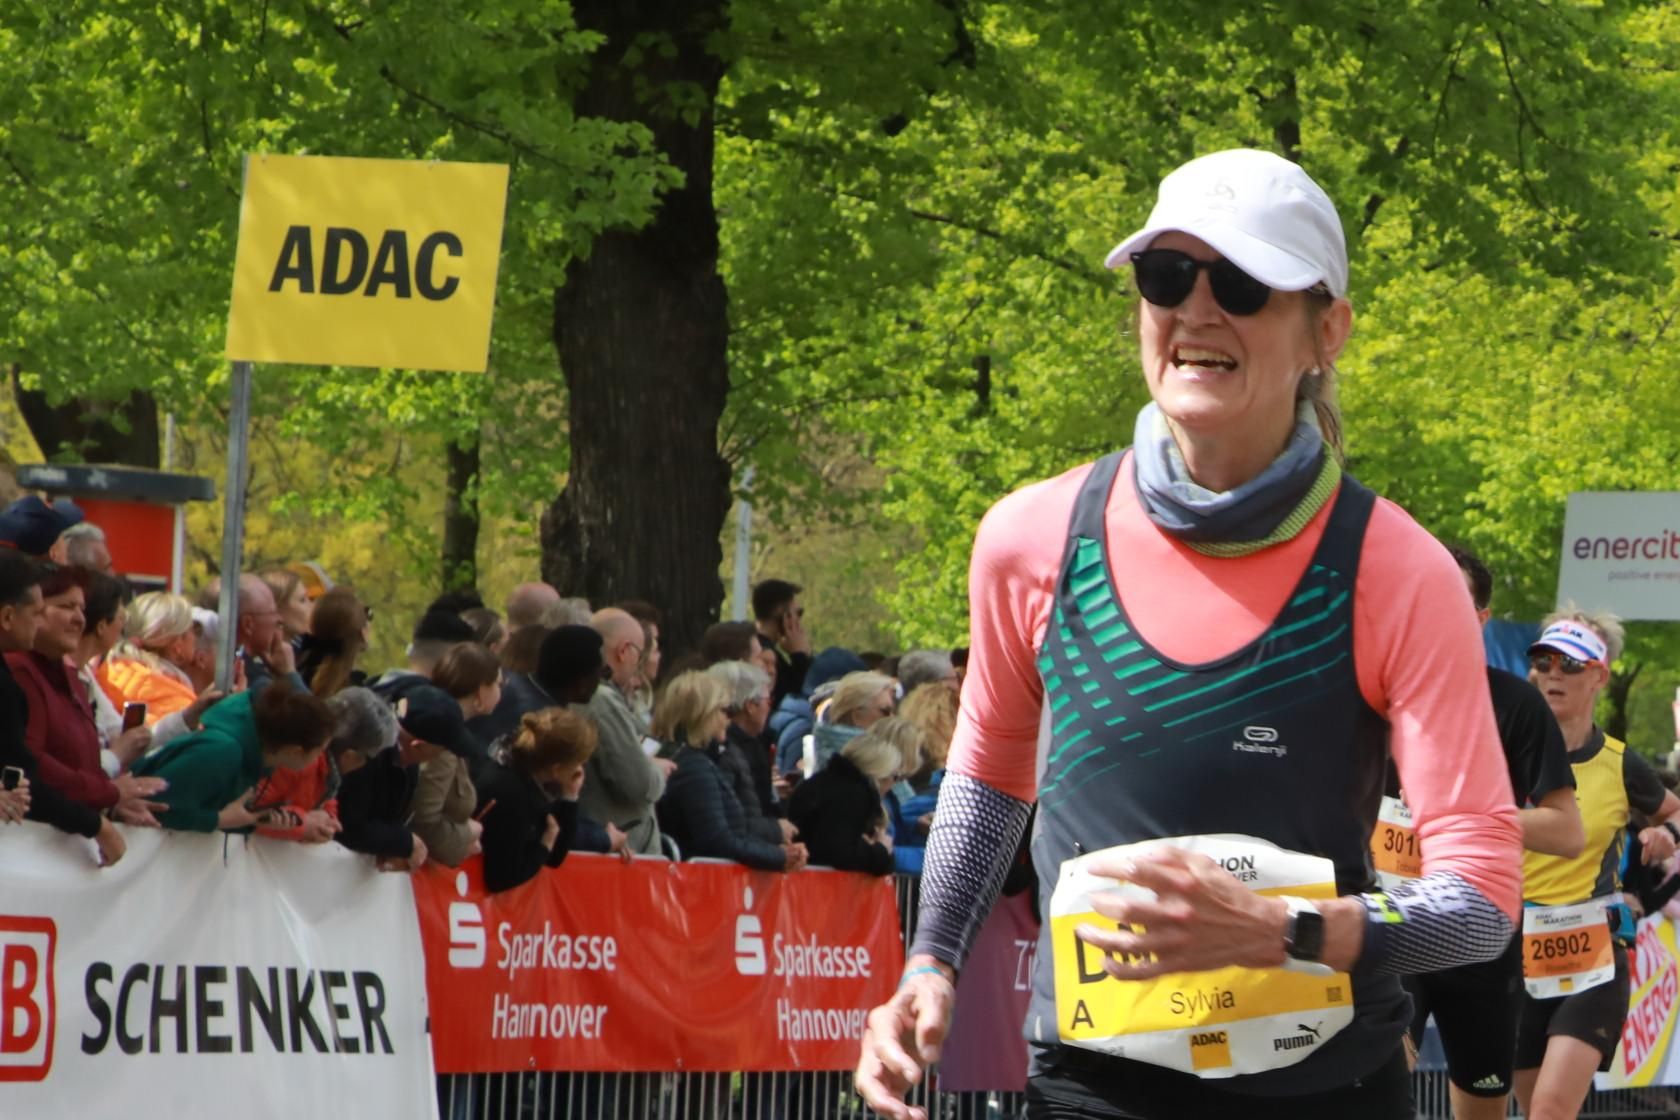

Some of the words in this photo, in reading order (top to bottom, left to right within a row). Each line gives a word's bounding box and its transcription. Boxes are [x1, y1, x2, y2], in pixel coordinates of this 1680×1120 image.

[268, 226, 463, 301] ADAC
[497, 920, 617, 981] Sparkasse
[773, 932, 872, 987] Sparkasse
[1531, 932, 1592, 961] 26902
[0, 946, 41, 1053] B
[81, 962, 395, 1055] SCHENKER
[492, 993, 608, 1039] Hannover
[777, 998, 868, 1040] Hannover
[1071, 1000, 1095, 1030] A
[1171, 987, 1236, 1019] Sylvia
[1191, 1031, 1227, 1048] ADAC
[1274, 1034, 1315, 1051] PUMA
